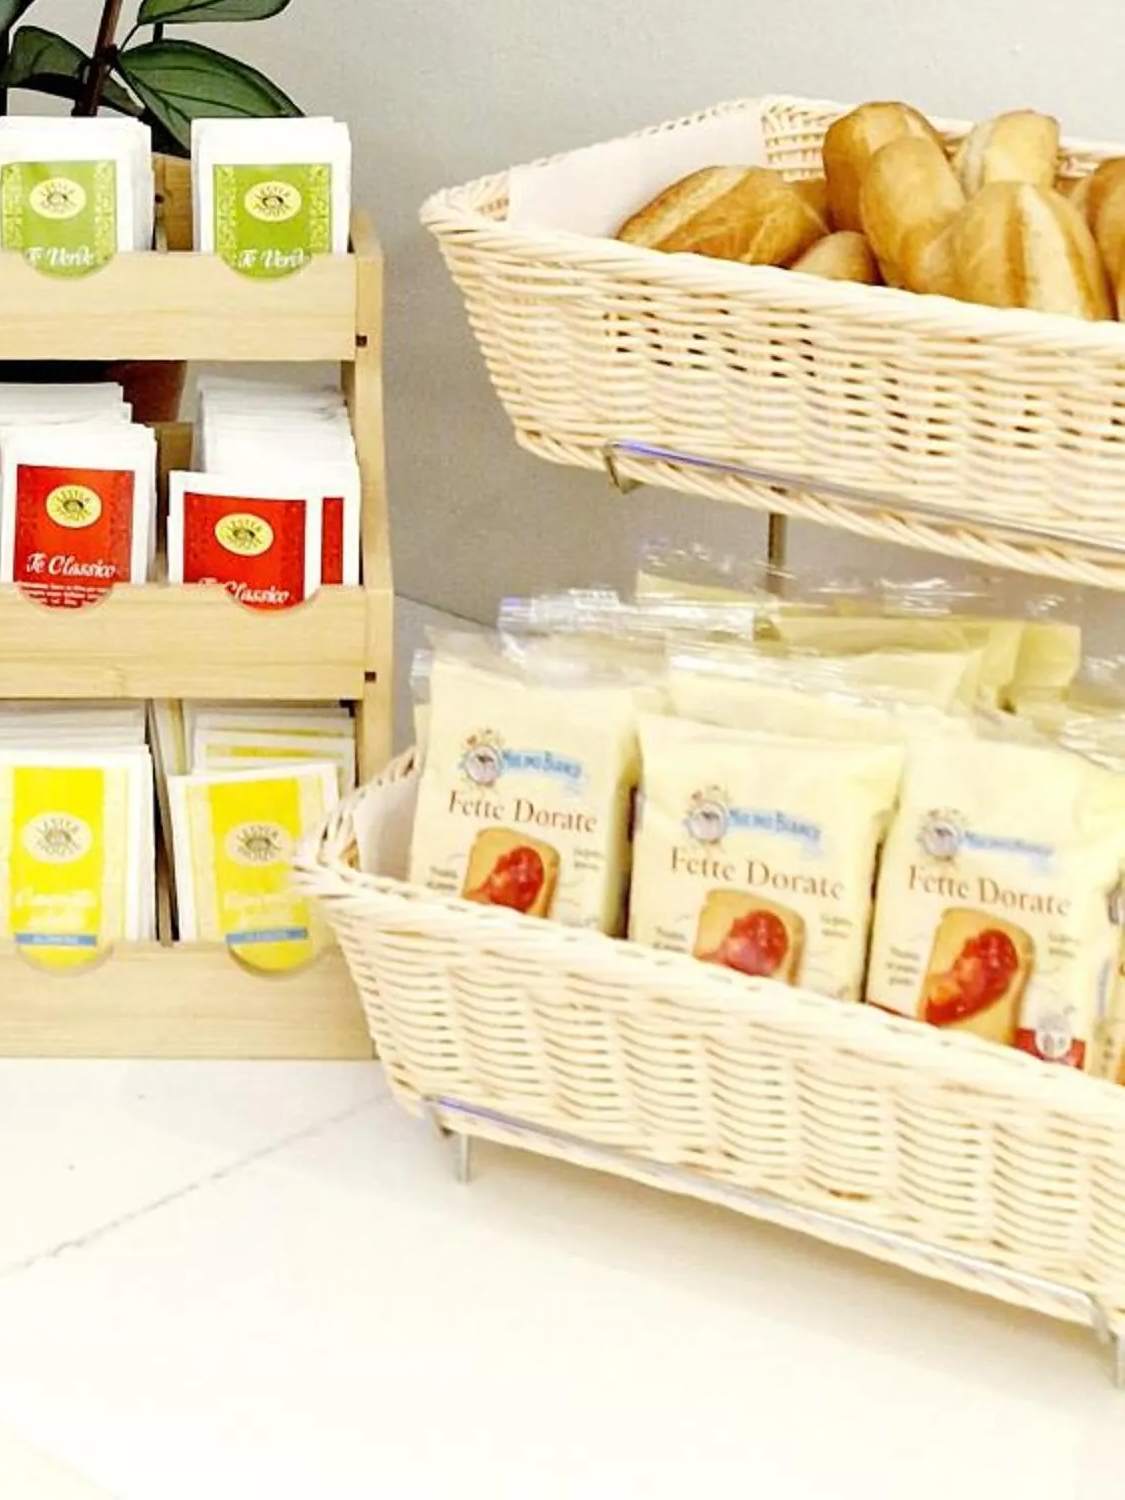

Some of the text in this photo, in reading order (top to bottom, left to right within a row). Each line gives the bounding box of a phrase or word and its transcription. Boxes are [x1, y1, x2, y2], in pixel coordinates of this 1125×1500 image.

[449, 790, 599, 834] Fette Dorate
[671, 846, 845, 901] Fette Dorate
[909, 864, 1072, 918] Fette Dorate
